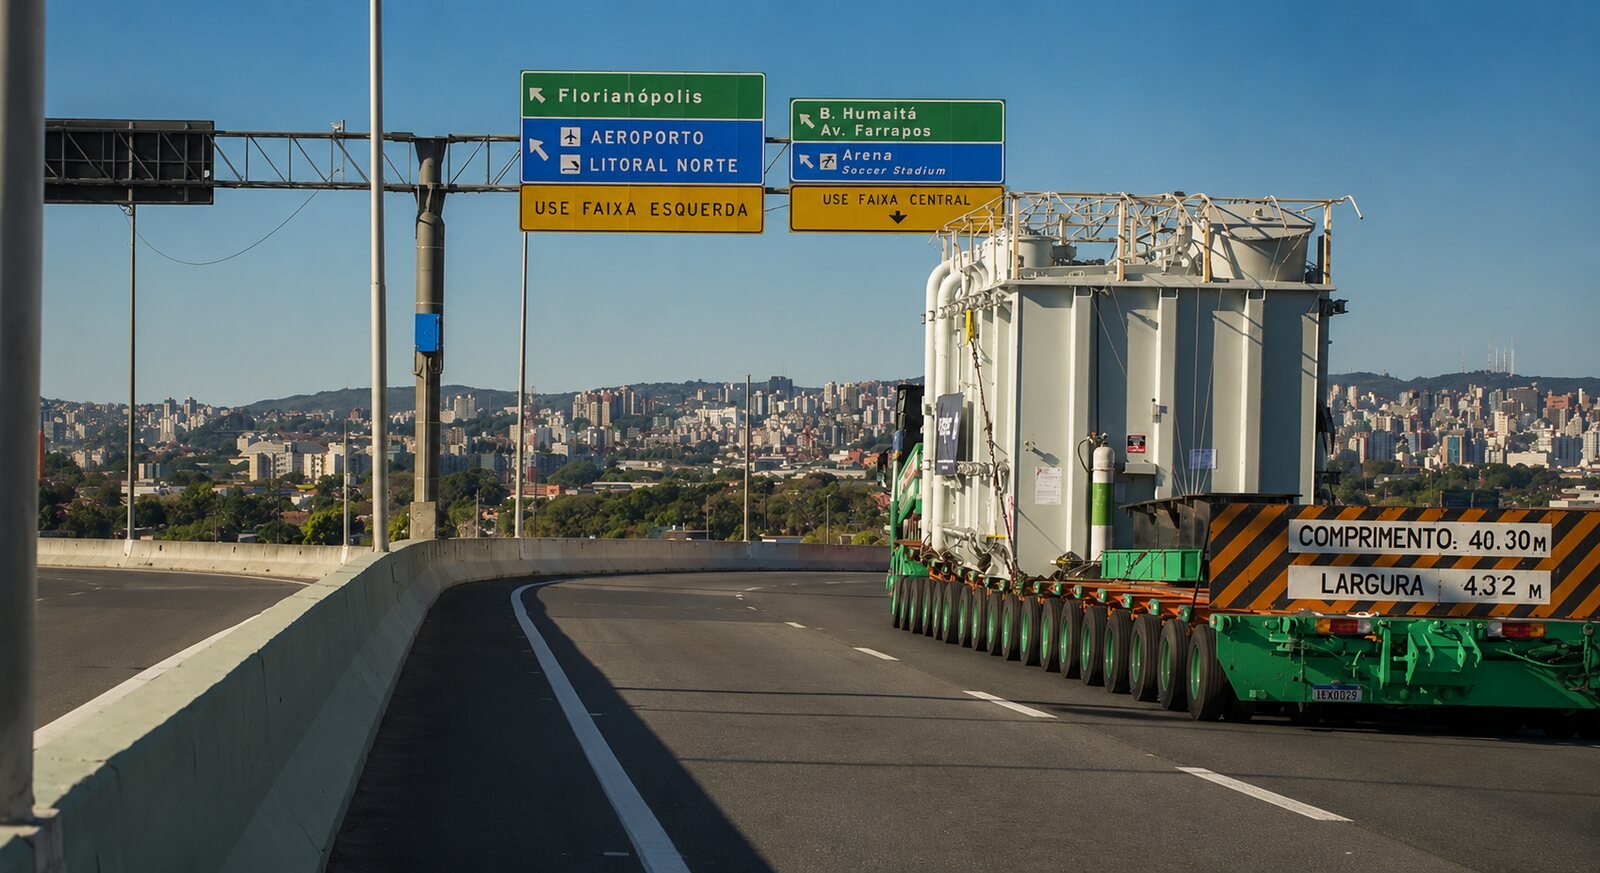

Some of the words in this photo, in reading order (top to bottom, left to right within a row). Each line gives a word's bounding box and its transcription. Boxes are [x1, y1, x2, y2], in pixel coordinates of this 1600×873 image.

[558, 88, 702, 107] Florianópolis
[820, 107, 836, 120] B.
[843, 106, 917, 120] Humaitá
[590, 130, 704, 145] AEROPORTO
[820, 123, 846, 137] Av.
[855, 124, 932, 140] Farrapos
[842, 148, 892, 161] Arena
[590, 157, 668, 173] LITORAL
[676, 158, 738, 173] NORTE
[841, 165, 887, 175] Soccer
[892, 165, 946, 176] Stadium
[823, 193, 849, 206] USE
[858, 193, 899, 206] FAIXA
[909, 193, 971, 206] CENTRAL
[535, 200, 570, 216] USE
[582, 201, 637, 217] FAIXA
[650, 201, 748, 217] ESQUERDA
[1299, 525, 1457, 550] COMPRIMENTO:
[1321, 573, 1425, 596] LARGURA
[1463, 575, 1516, 596] 4.32
[1529, 584, 1542, 599] M
